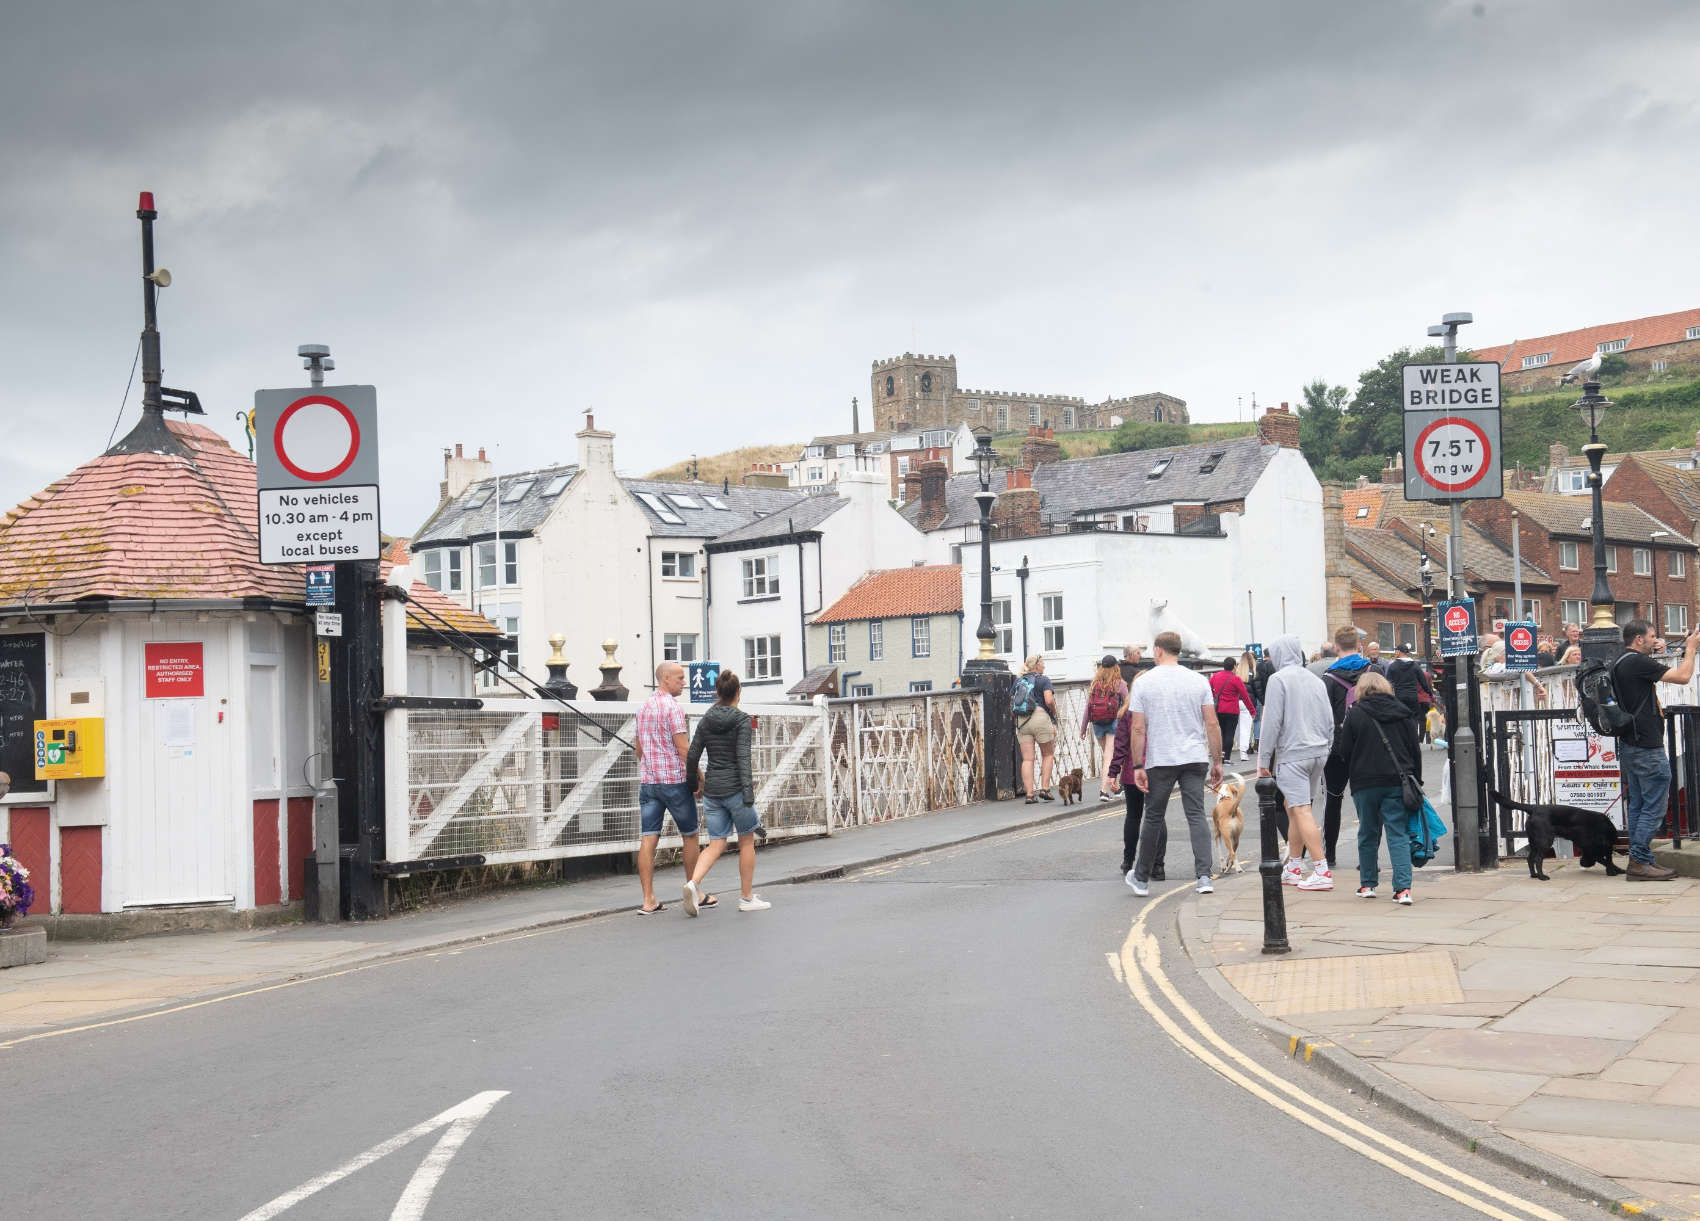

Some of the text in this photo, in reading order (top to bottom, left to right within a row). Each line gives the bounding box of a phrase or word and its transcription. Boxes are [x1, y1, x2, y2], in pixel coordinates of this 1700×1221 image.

[1420, 368, 1482, 384] WEAK
[1410, 388, 1492, 405] BRIDGE
[279, 493, 359, 506] No vehicles
[265, 513, 305, 525] 10.30
[309, 514, 329, 523] am
[340, 511, 349, 522] 4
[353, 512, 373, 523] pm
[297, 530, 343, 542] except
[281, 544, 359, 556] local buses
[1453, 611, 1461, 619] NO
[1448, 618, 1466, 626] ACCESS
